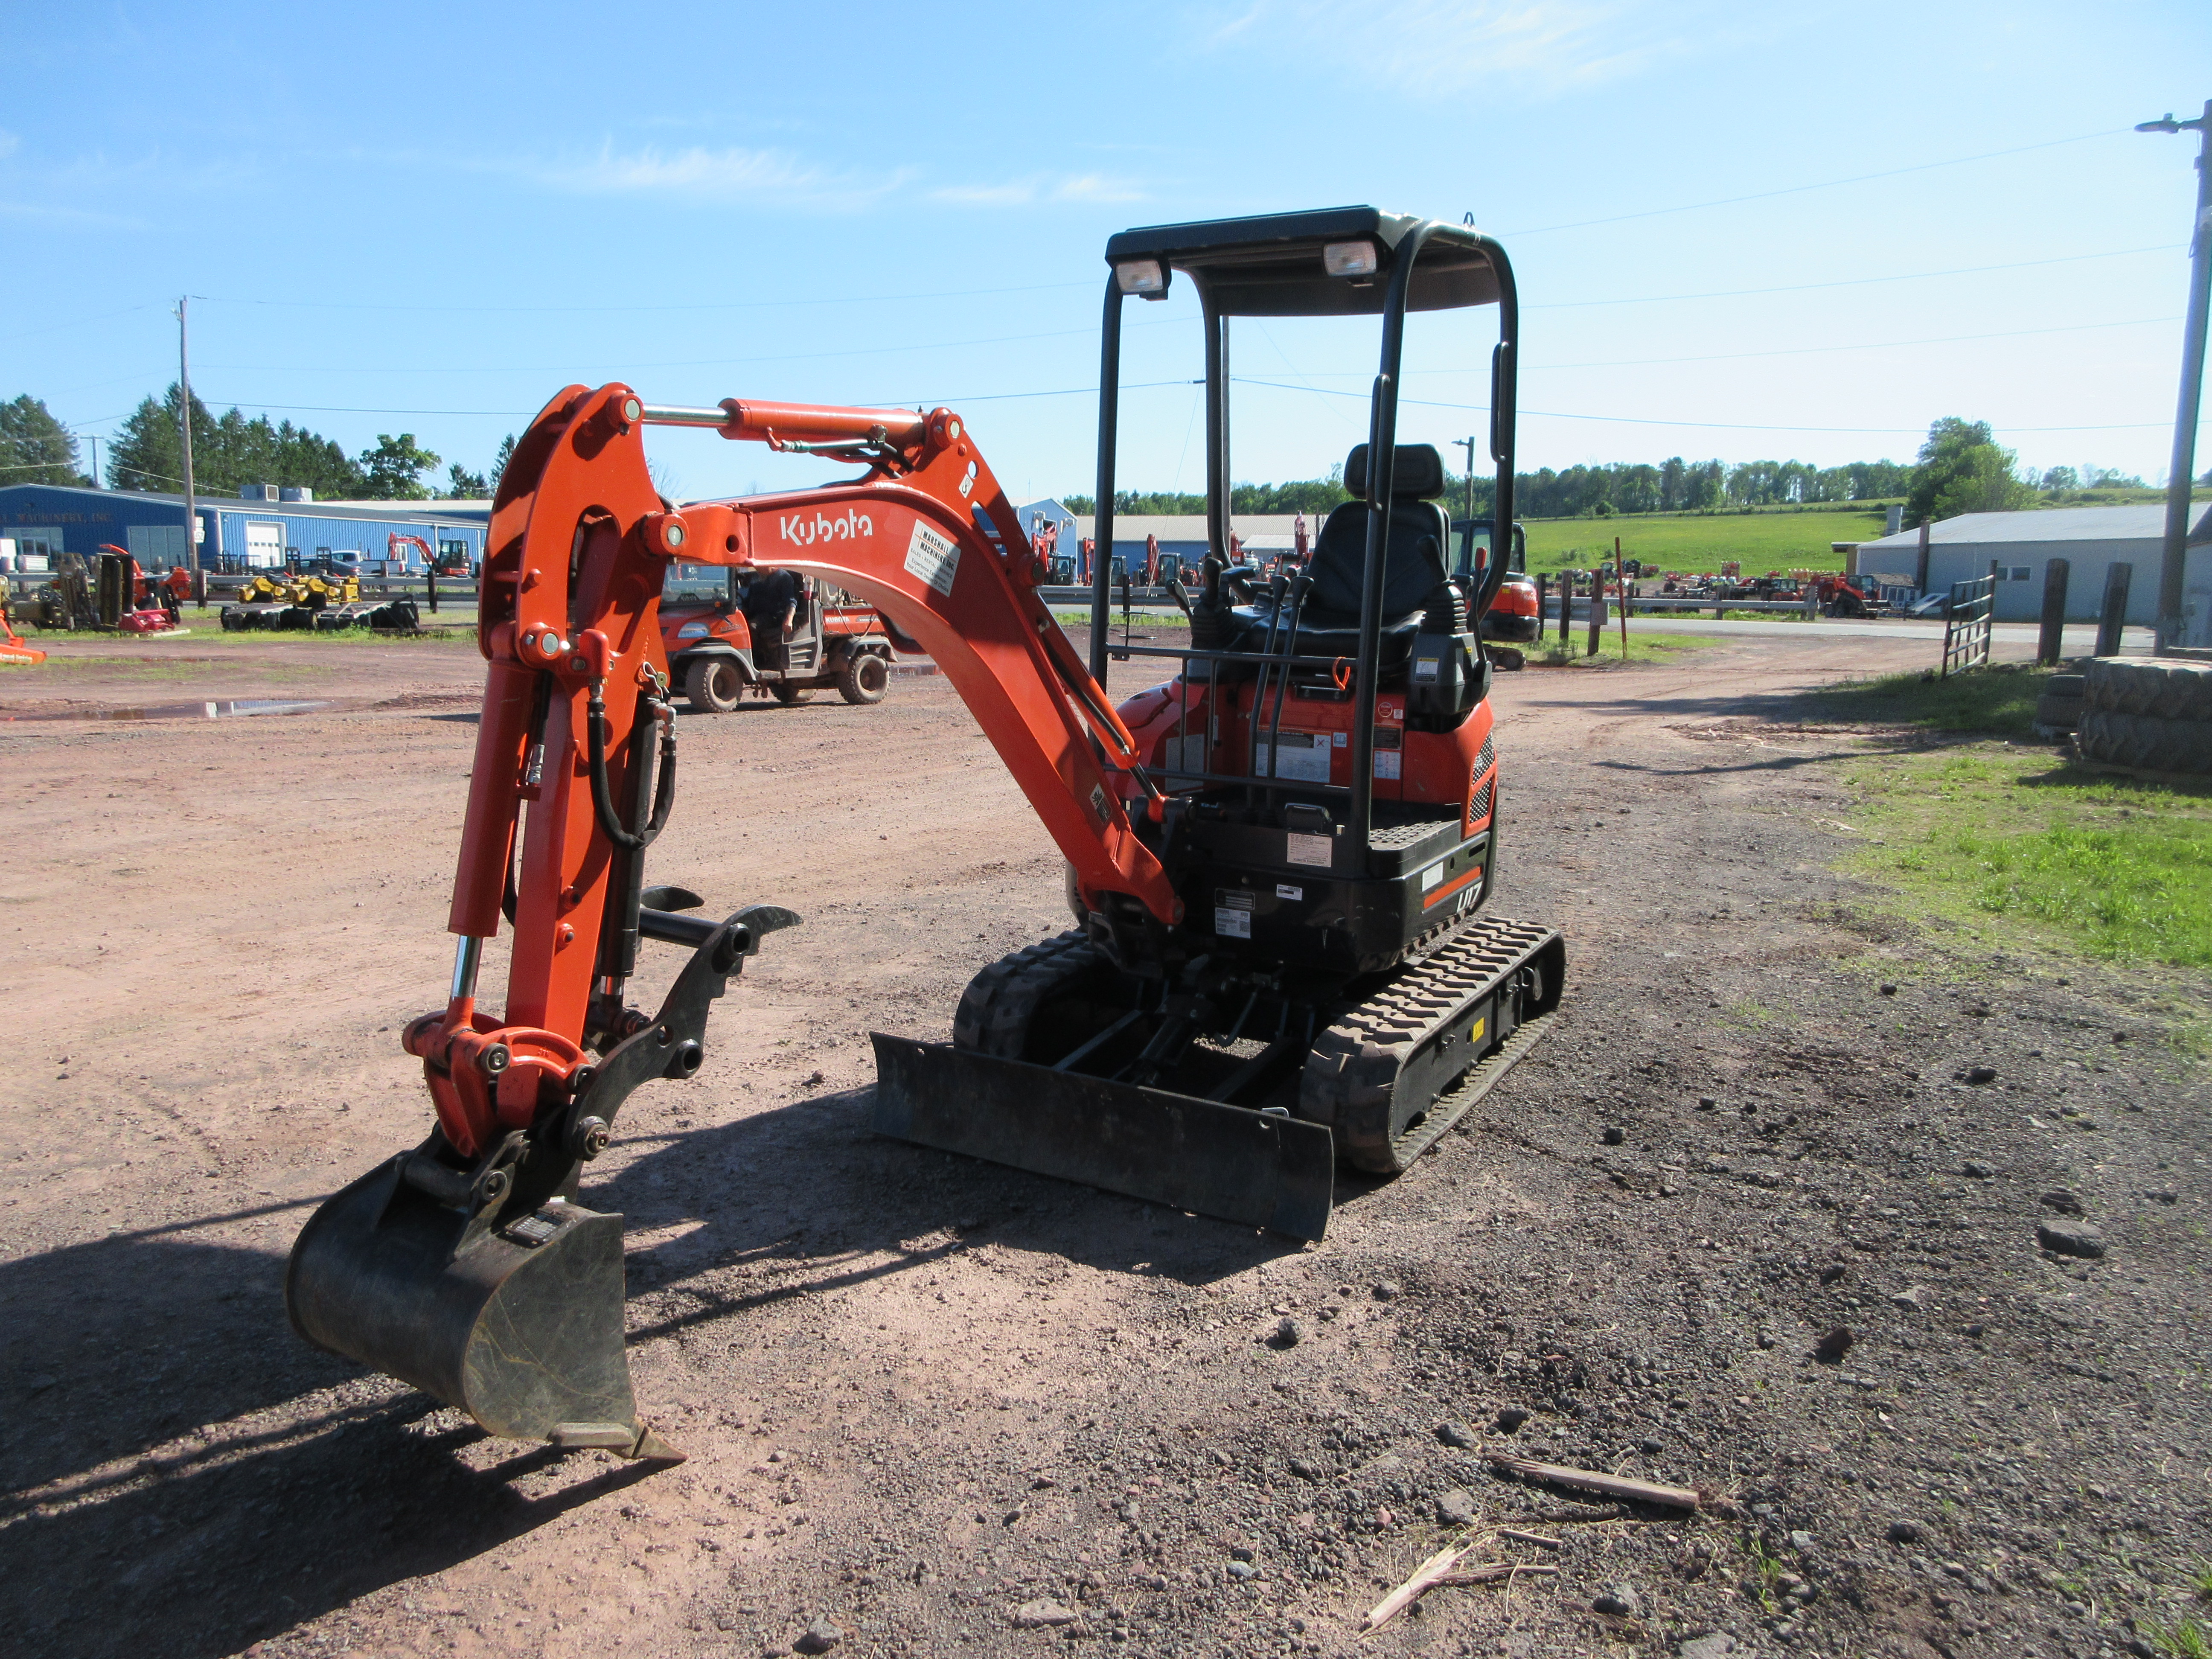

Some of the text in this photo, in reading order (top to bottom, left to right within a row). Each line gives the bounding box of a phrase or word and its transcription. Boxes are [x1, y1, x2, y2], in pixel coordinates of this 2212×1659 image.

[780, 508, 873, 546] Kubota
[923, 530, 949, 555] MARSHALL
[906, 561, 914, 570] Your
[914, 567, 923, 576] Local
[923, 572, 934, 583] Dealer
[910, 548, 952, 579] SALES RENTAL SERVICE
[911, 557, 929, 573] Experience
[946, 559, 955, 571] Inc.
[1457, 881, 1483, 913] U17
